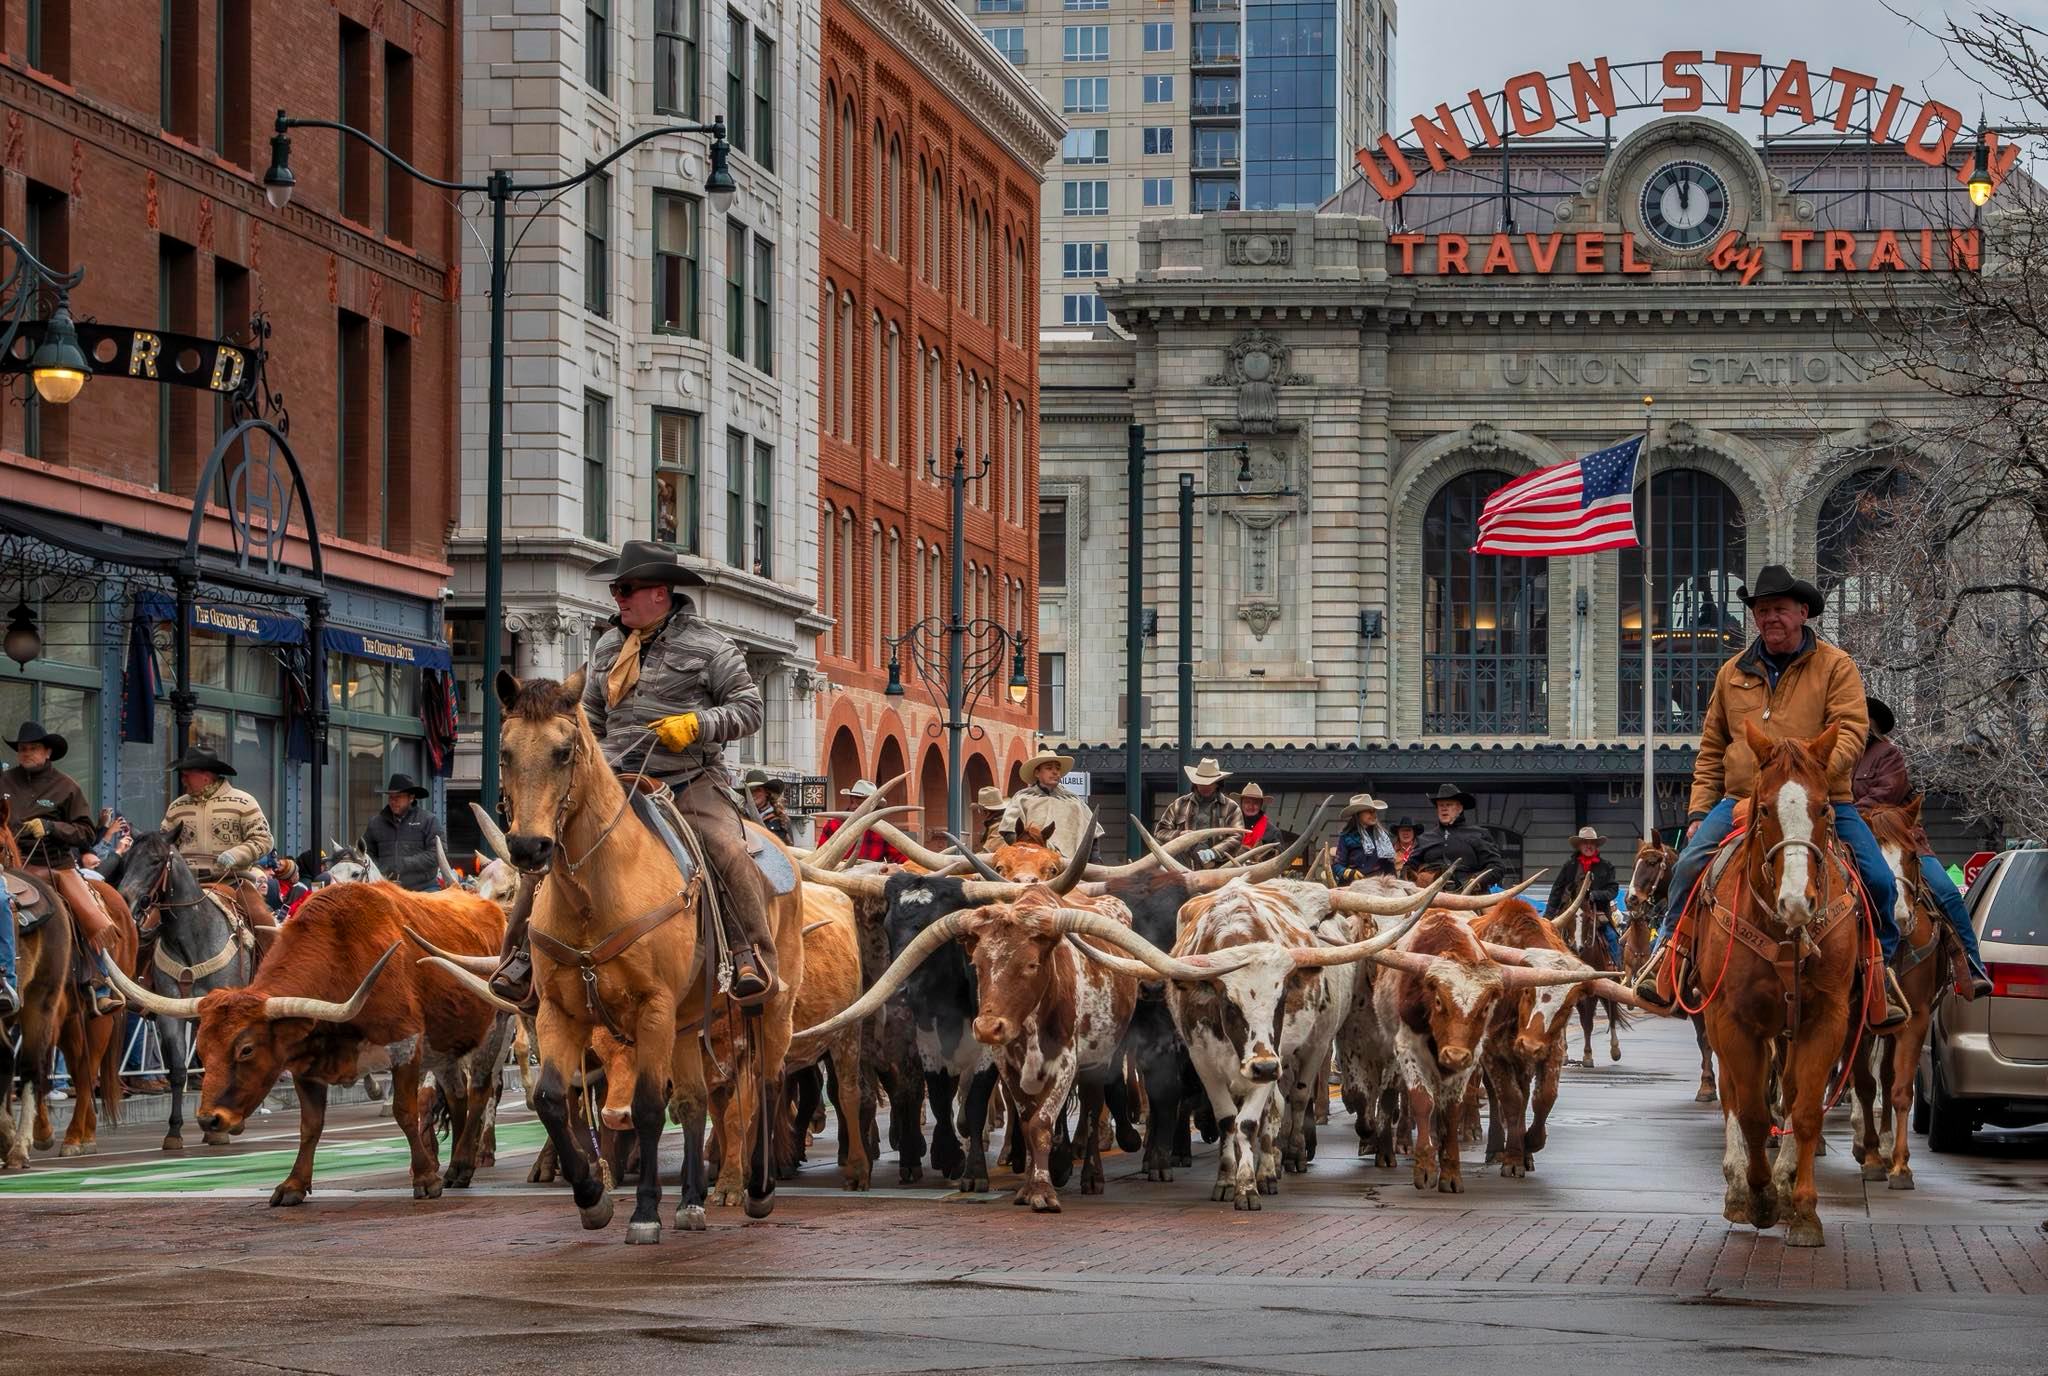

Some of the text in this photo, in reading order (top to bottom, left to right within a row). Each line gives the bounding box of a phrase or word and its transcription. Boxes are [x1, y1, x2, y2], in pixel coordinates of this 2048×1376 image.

[1355, 51, 2022, 201] UNION STATION
[1391, 229, 1981, 286] TRAVEL by TRAIN
[1502, 355, 1866, 385] UNION STATION
